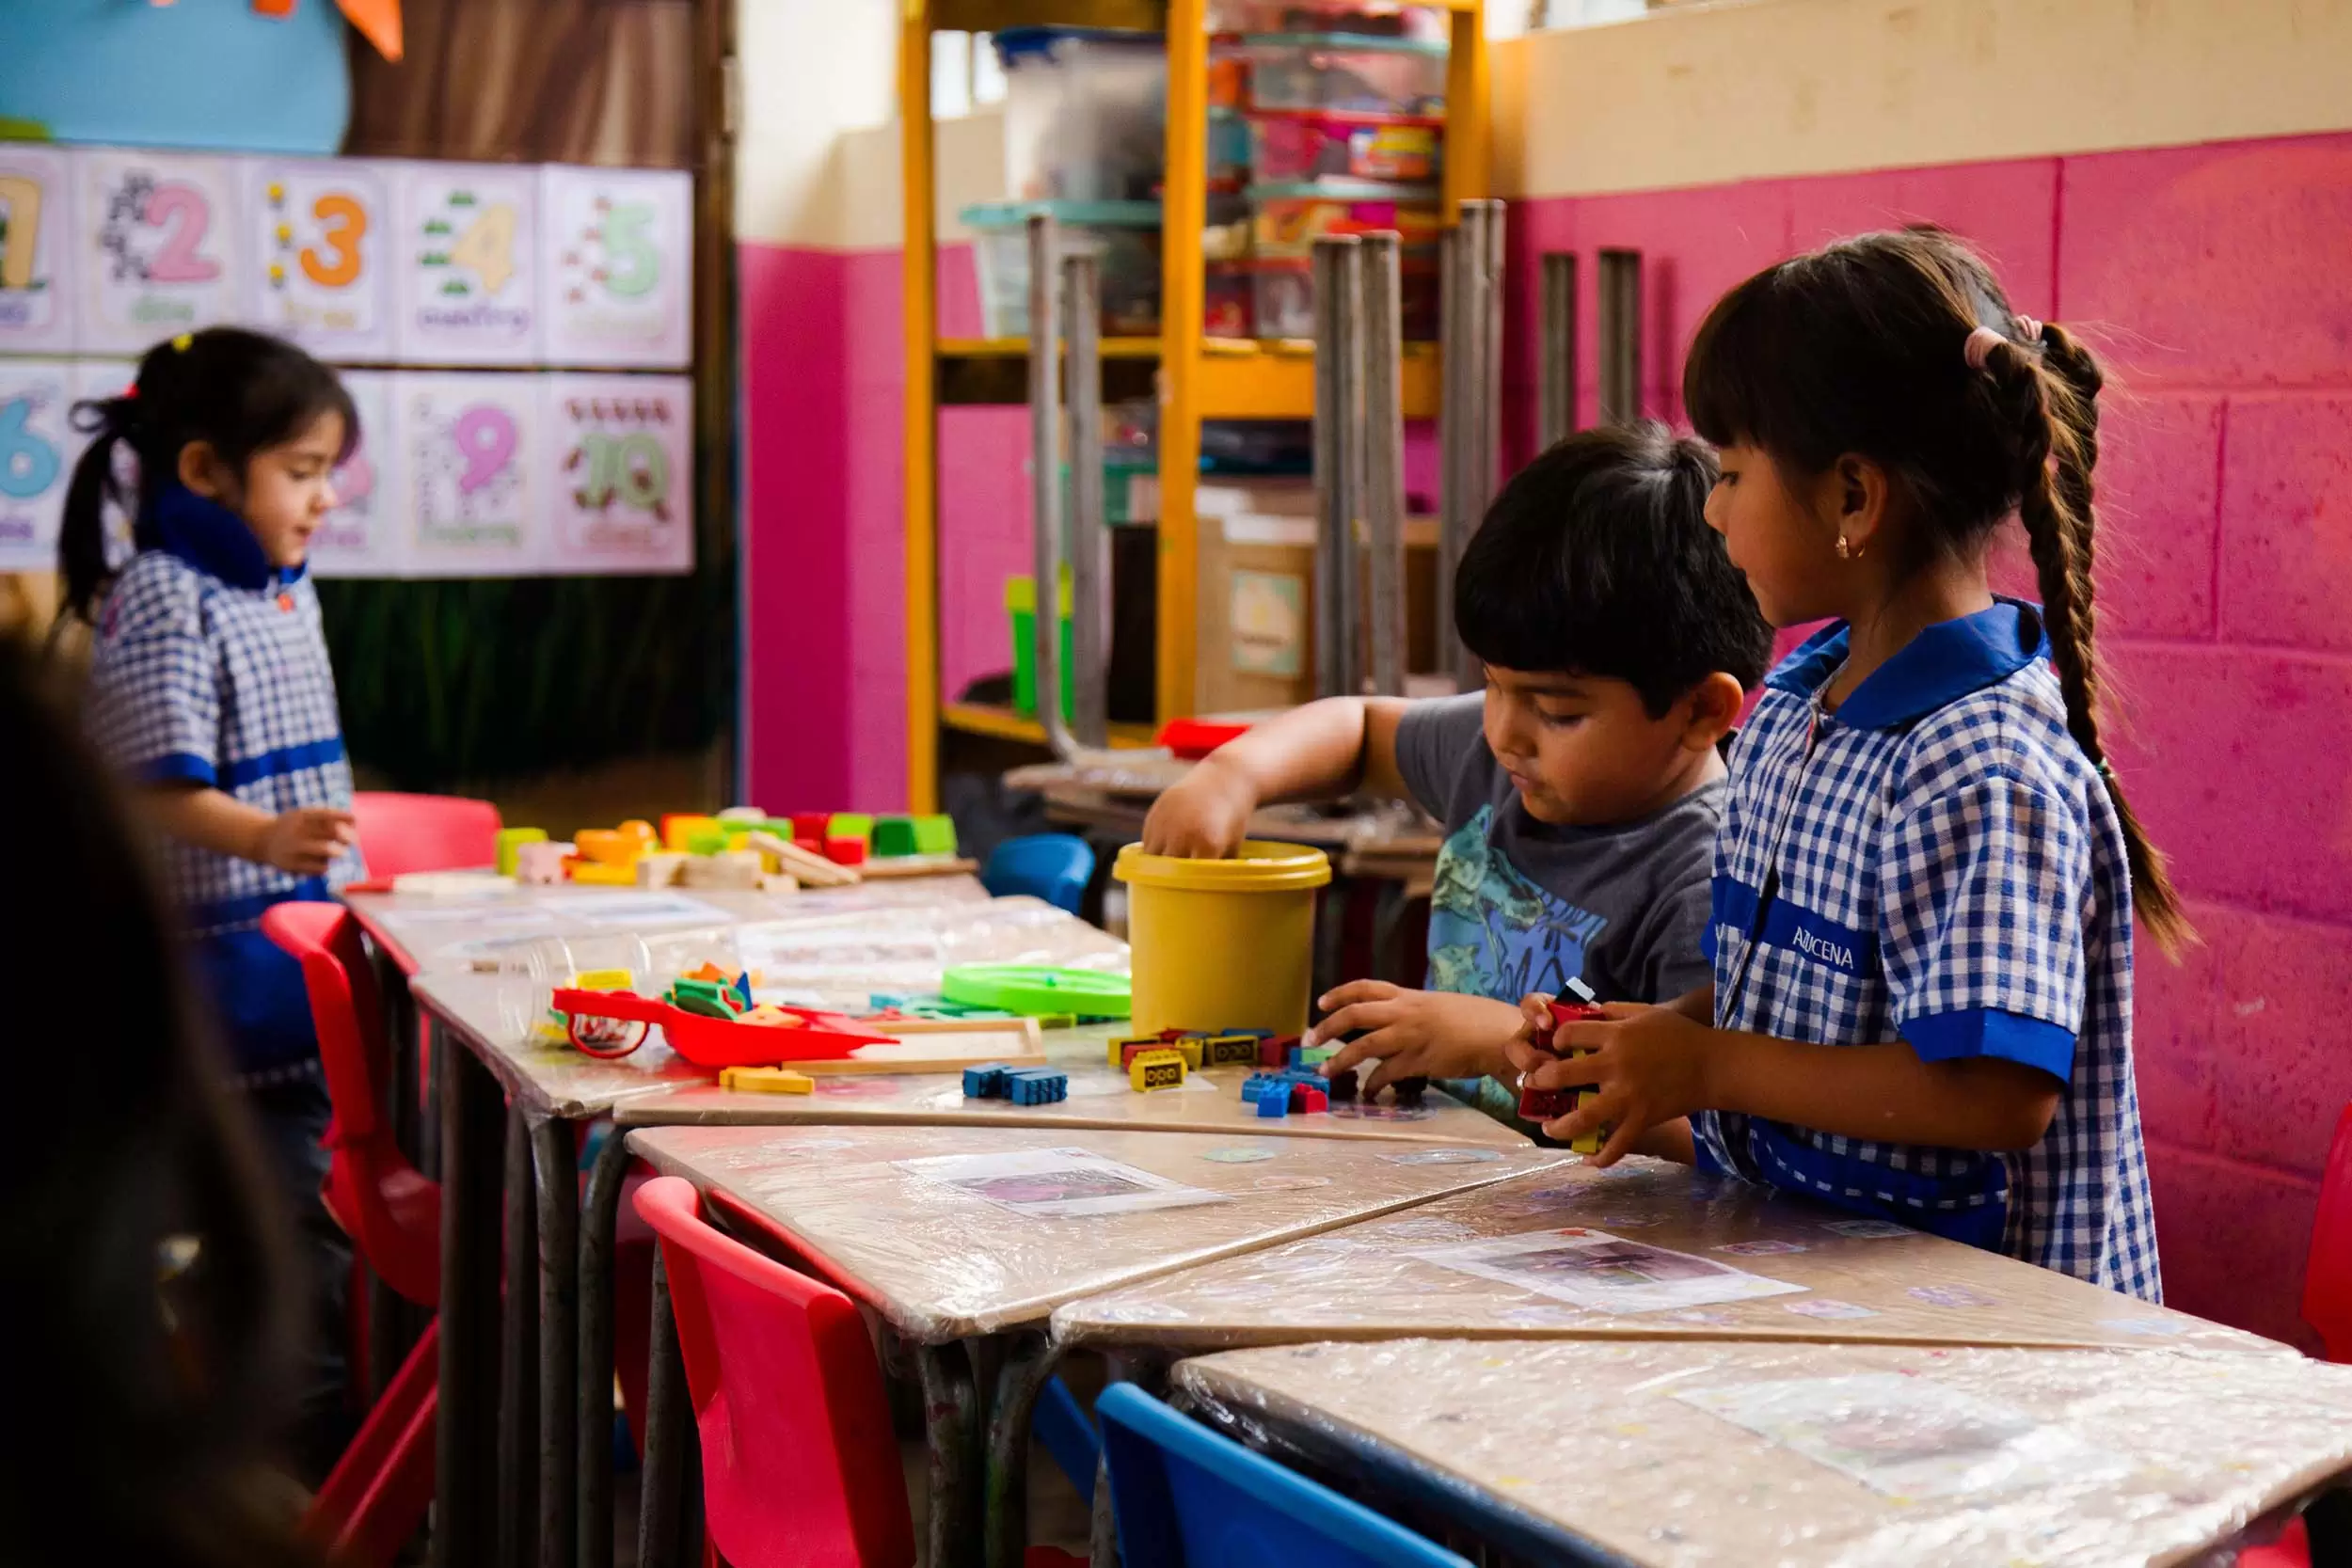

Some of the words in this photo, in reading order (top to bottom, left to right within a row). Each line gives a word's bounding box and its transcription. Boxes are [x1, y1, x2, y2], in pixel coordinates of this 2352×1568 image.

[147, 184, 220, 282] 2
[299, 193, 368, 290] 3
[449, 201, 515, 297] 4
[602, 202, 662, 298] 5
[0, 399, 60, 499] 6
[456, 406, 516, 493] 9
[577, 430, 672, 513] 10
